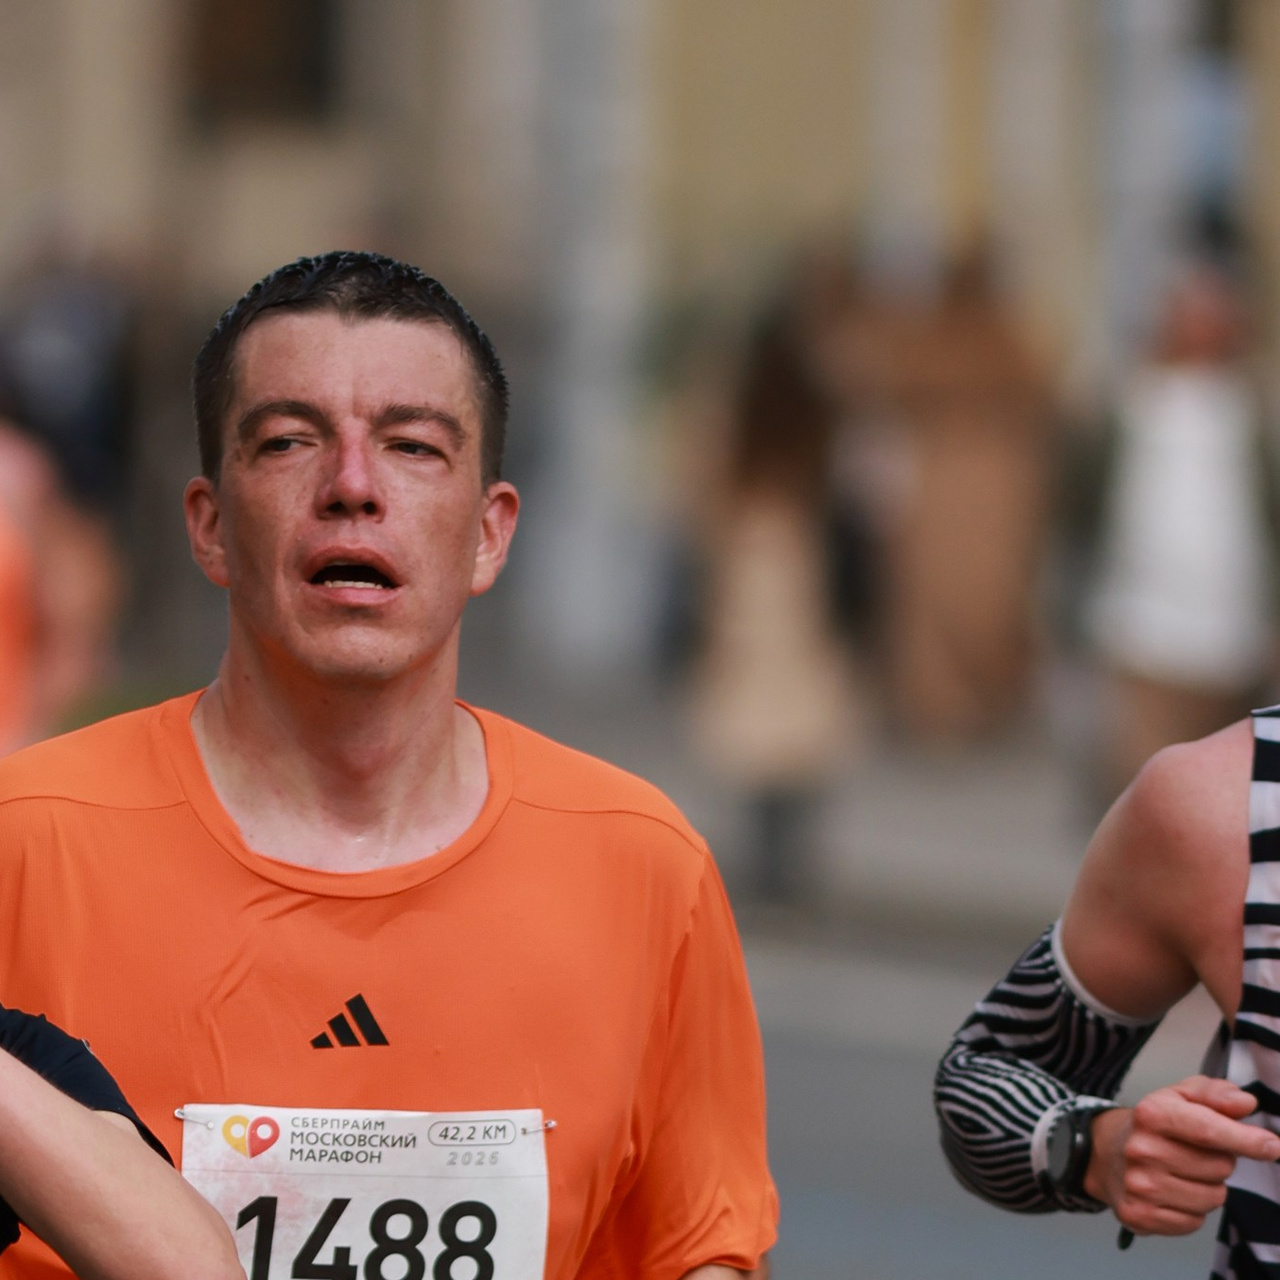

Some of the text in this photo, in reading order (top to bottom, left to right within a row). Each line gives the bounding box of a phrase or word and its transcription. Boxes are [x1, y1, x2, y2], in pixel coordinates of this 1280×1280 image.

[290, 1116, 386, 1131] СБЕРПРАЙМ
[289, 1130, 418, 1149] МОСКОВСКИЙ
[438, 1125, 477, 1143] 42,2
[288, 1147, 383, 1164] МАРАФОН
